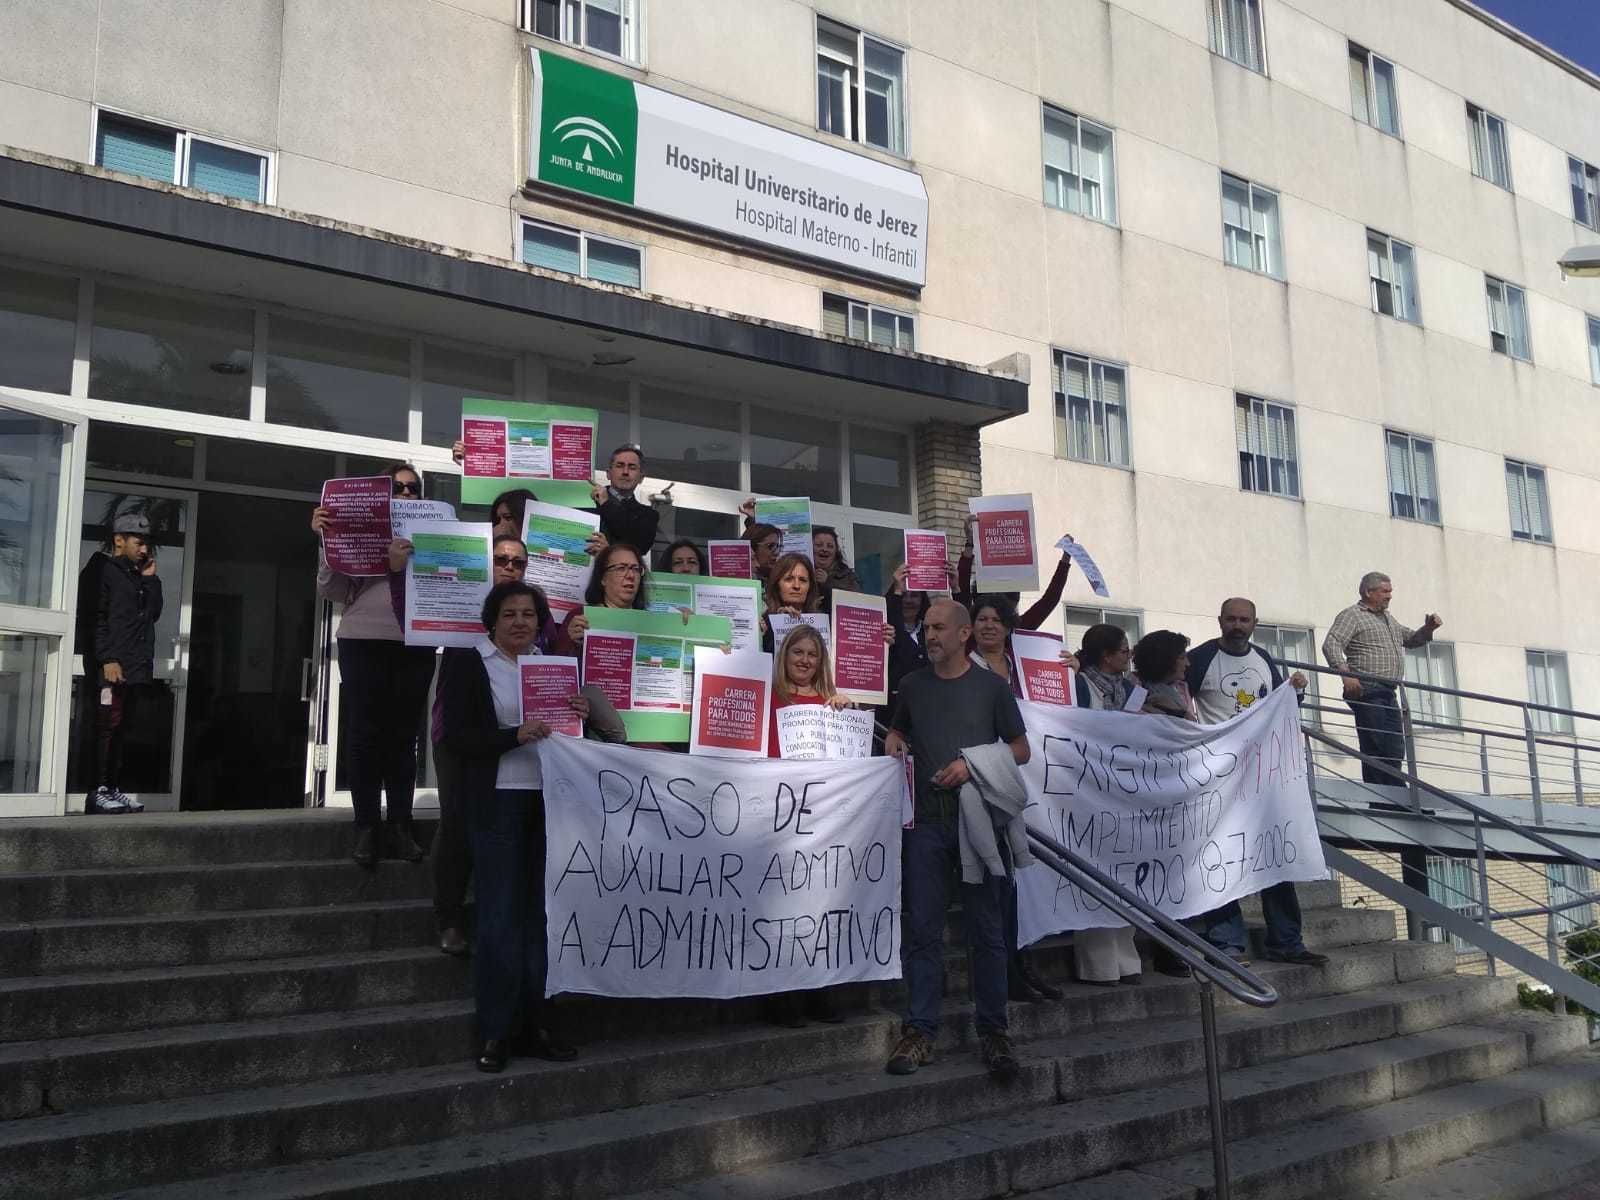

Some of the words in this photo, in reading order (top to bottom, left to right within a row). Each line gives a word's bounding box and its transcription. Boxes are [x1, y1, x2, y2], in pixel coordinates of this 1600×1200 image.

[550, 154, 572, 168] JUNTA
[575, 161, 584, 172] DE
[587, 165, 624, 183] ANDALUCIA
[665, 144, 739, 186] Hospital
[745, 168, 849, 218] Universitario
[853, 202, 873, 224] de
[877, 209, 918, 238] Jerez
[735, 199, 798, 236] Hospital
[801, 219, 860, 253] Materno
[872, 237, 918, 269] Infantil
[986, 536, 1002, 544] PARA
[1004, 536, 1024, 544] TODOS
[708, 696, 756, 711] PROFESIONAL
[724, 688, 756, 700] CARRERA
[1032, 685, 1046, 696] PARA
[708, 708, 728, 720] PARA
[731, 710, 756, 723] TODOS
[784, 710, 818, 720] CARRERA
[1043, 734, 1238, 795] EXIGIMOS
[598, 769, 741, 841] PASO
[773, 781, 827, 835] DE
[1024, 790, 1222, 858] UMPLIMIENTO
[554, 840, 744, 898] AUXILIAR
[757, 841, 886, 895] ADMTVO
